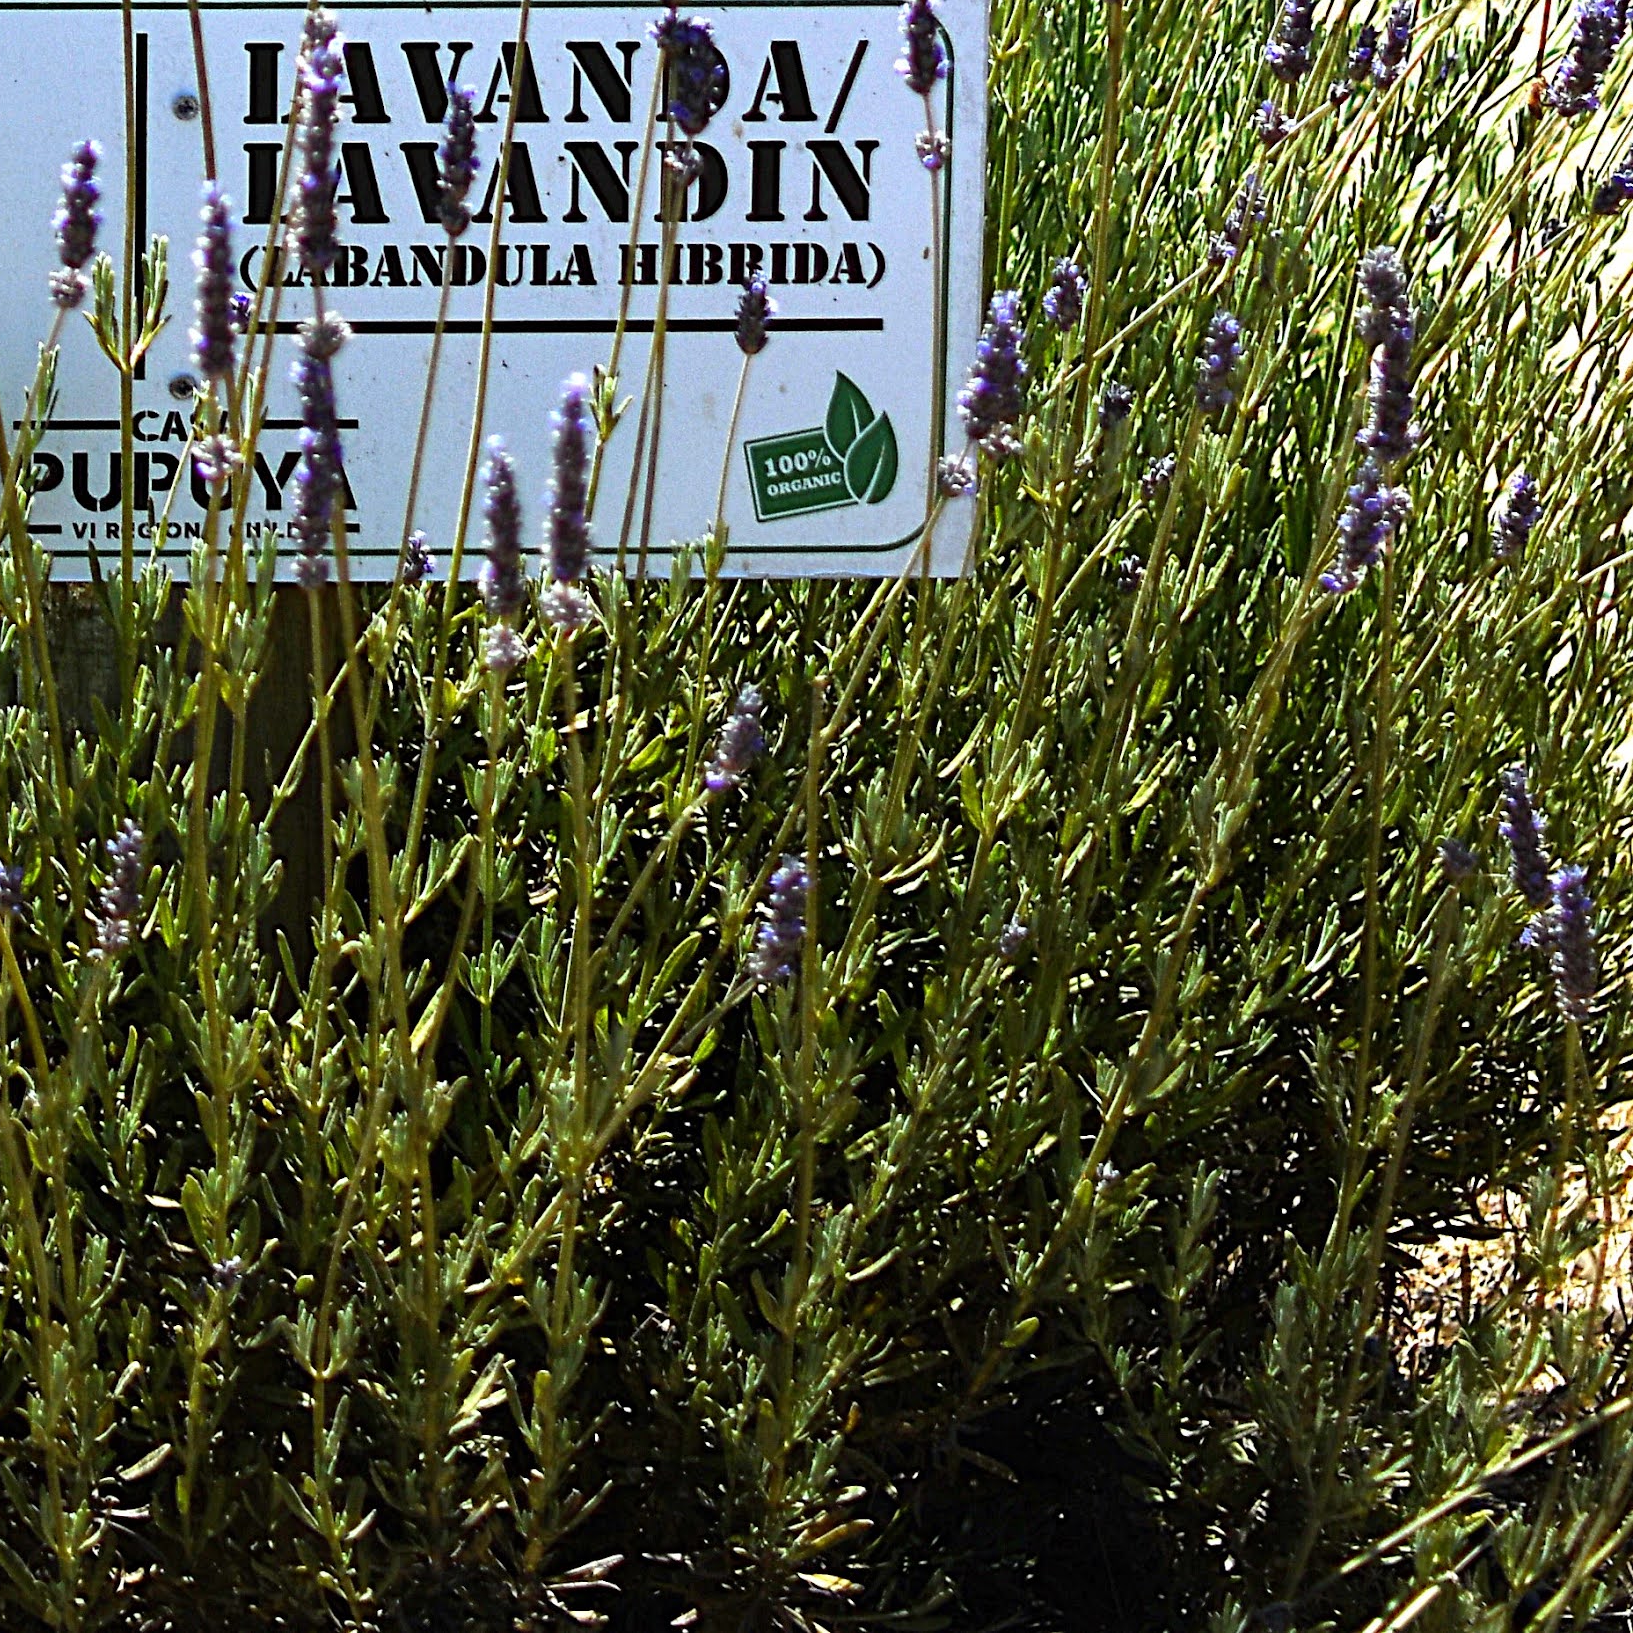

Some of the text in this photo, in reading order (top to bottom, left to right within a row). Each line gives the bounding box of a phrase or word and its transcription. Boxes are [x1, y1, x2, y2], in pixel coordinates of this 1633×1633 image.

[242, 139, 880, 224] LAVANDIN
[618, 242, 886, 289] HIBRIDA)
[764, 447, 831, 478] 100%
[767, 471, 842, 497] ORGANIC
[106, 522, 200, 539] RGON
